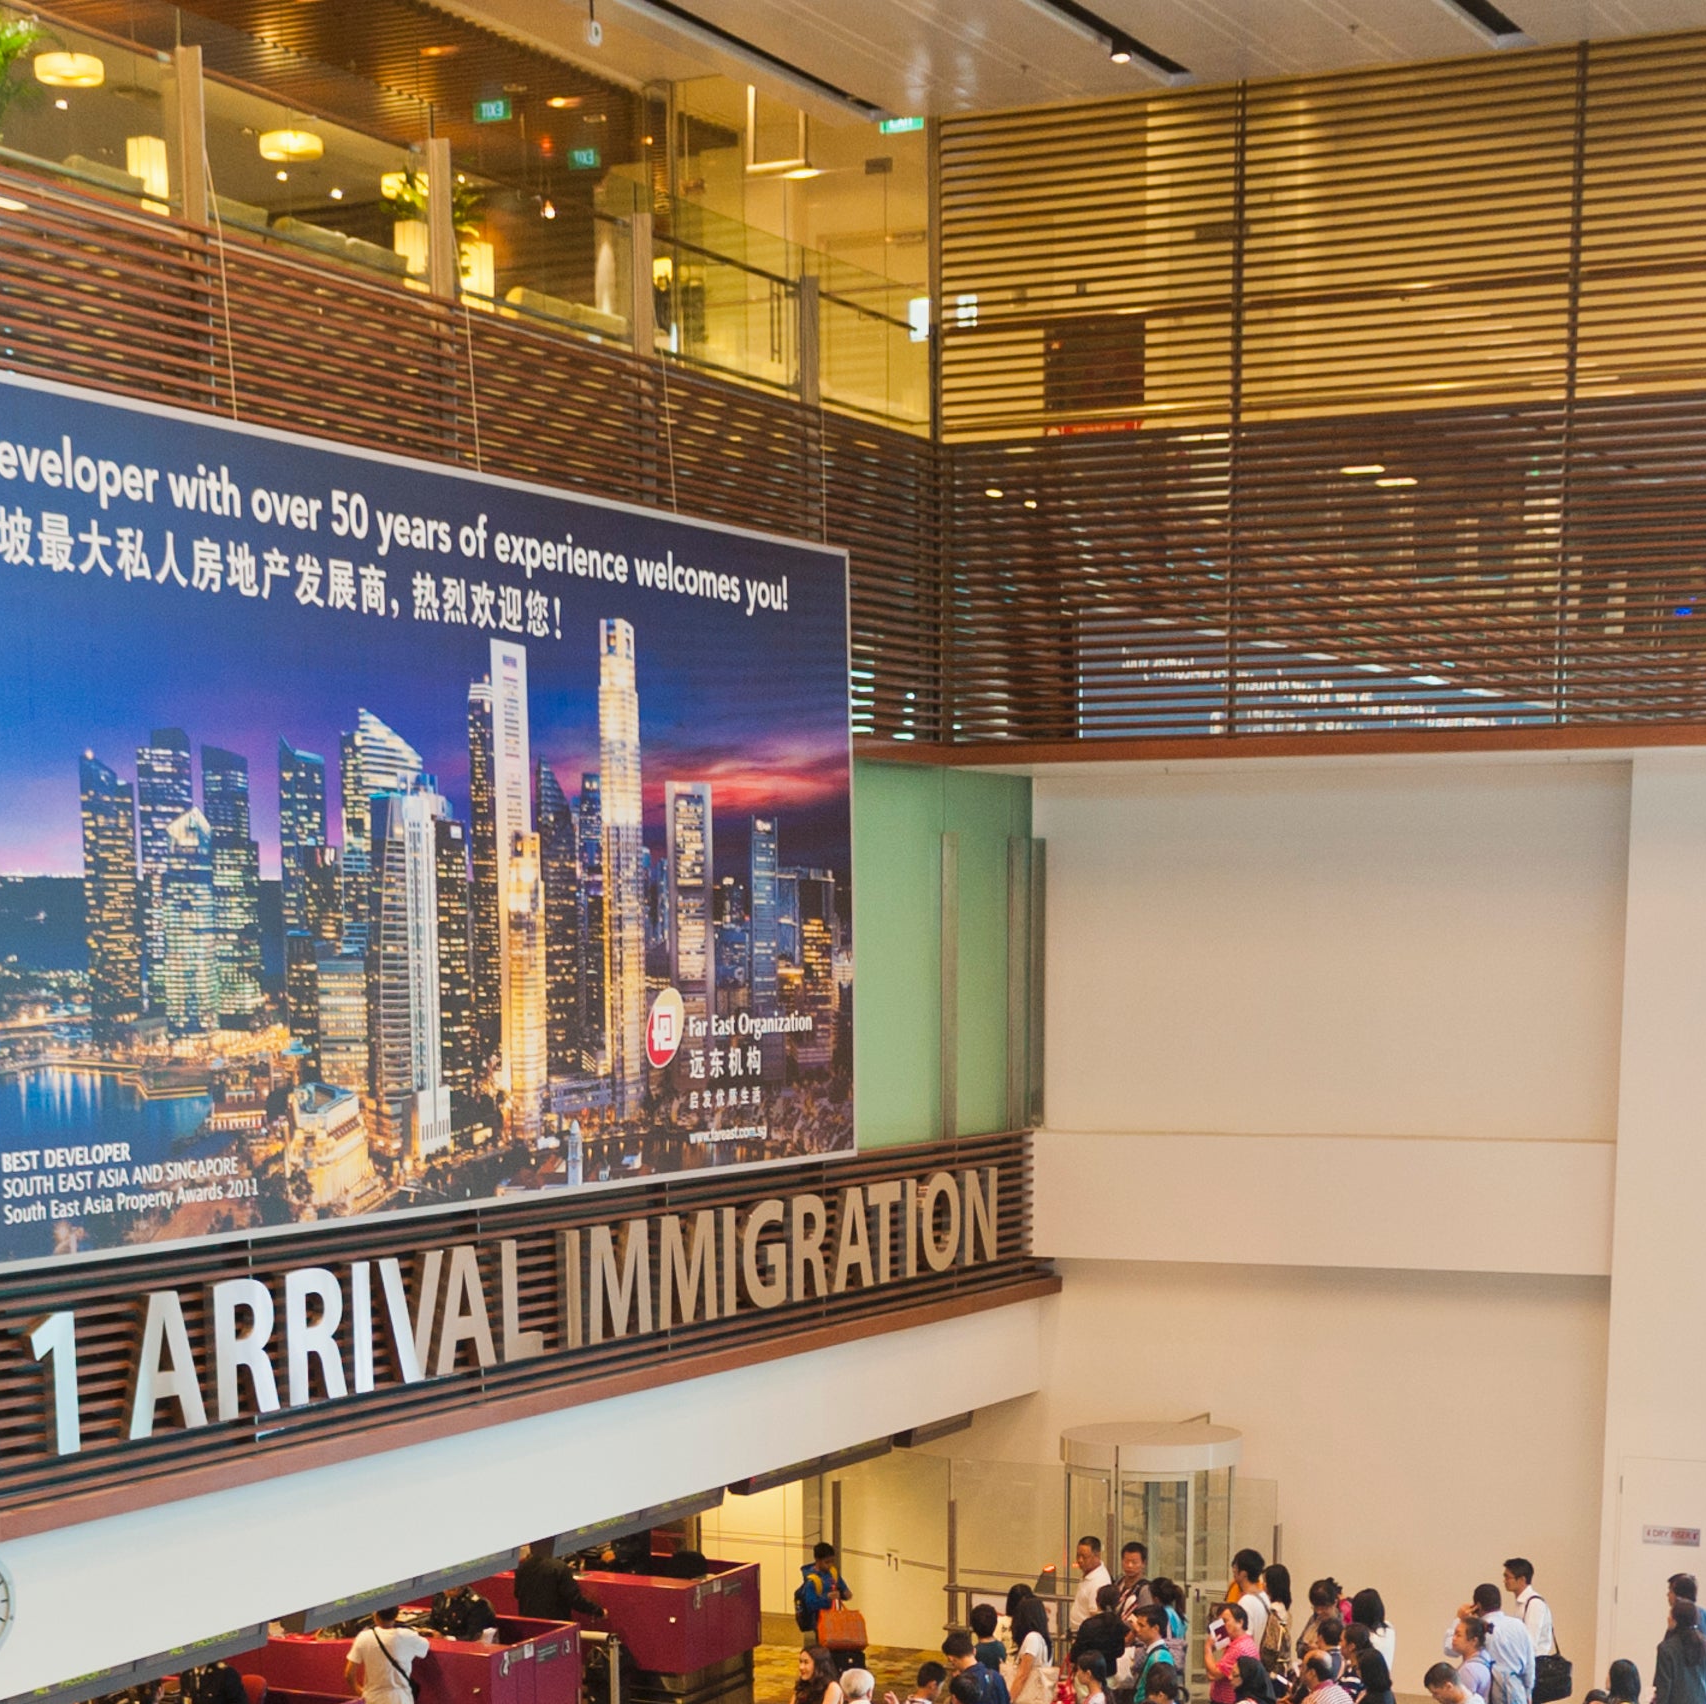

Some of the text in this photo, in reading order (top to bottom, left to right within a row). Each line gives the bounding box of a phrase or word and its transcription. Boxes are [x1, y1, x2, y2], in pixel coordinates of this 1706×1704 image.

[168, 464, 241, 518] with
[252, 487, 323, 532] over
[330, 490, 369, 540] 50
[376, 508, 452, 556] years
[459, 514, 488, 560] of
[494, 532, 629, 584] experience
[634, 551, 740, 603] welcomes
[745, 575, 789, 616] you!
[689, 1010, 813, 1040] Far East Organization
[689, 1045, 762, 1079] 远东机构
[1, 1142, 131, 1174] BEST DEVELOPER
[2, 1156, 238, 1199] SOUTH EAST ASIA AND SINGAPORE
[4, 1177, 259, 1224] South East Asia Property Awards 2011
[31, 1310, 81, 1456] 1
[128, 1239, 543, 1441] ARRIVAL
[566, 1167, 1000, 1349] IMMIGRATION
